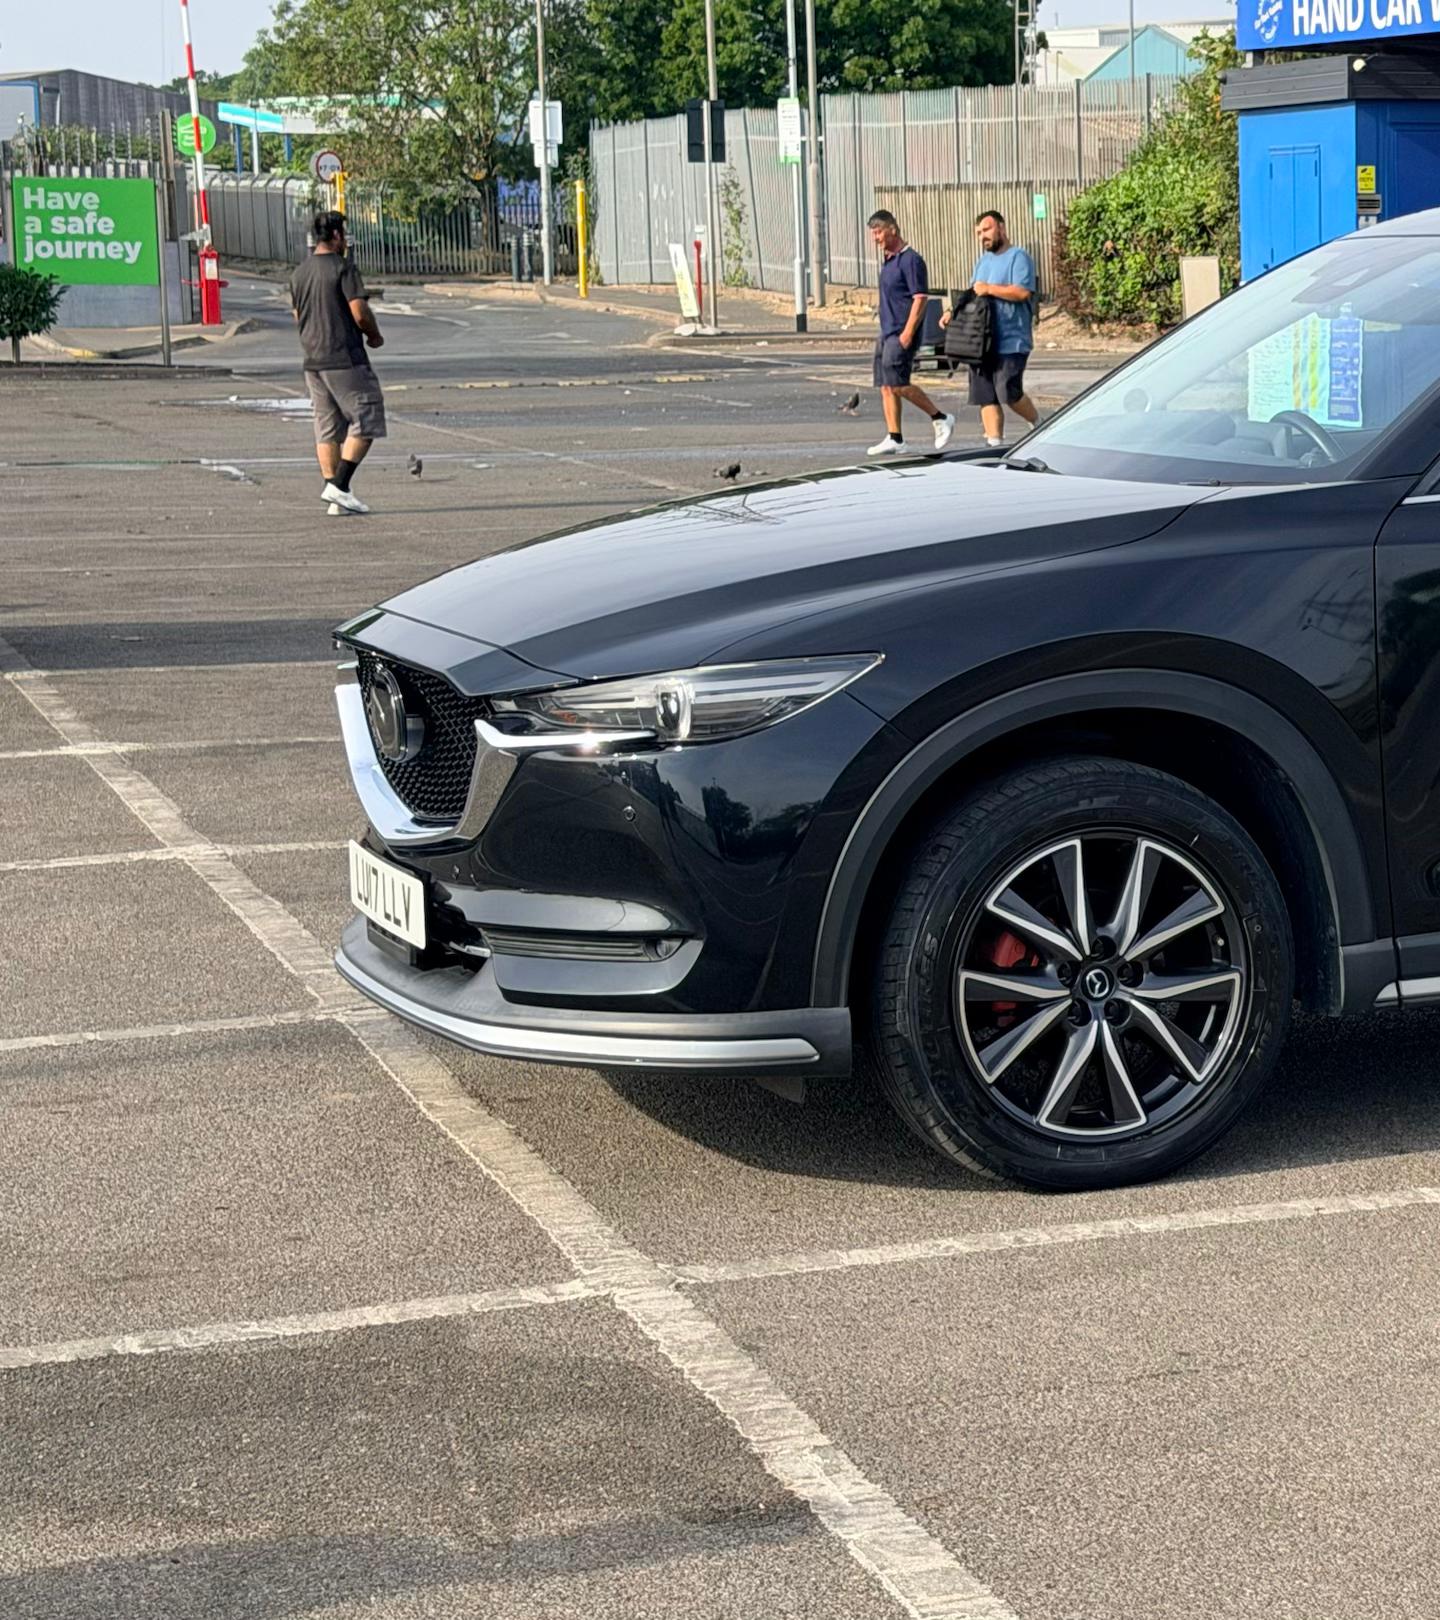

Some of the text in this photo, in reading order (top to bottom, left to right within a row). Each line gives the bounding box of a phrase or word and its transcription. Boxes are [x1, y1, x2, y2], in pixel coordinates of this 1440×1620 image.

[1292, 0, 1364, 36] HAND
[1370, 0, 1421, 30] CAR
[23, 186, 100, 210] Have
[24, 211, 115, 235] a safe
[24, 235, 142, 264] journey
